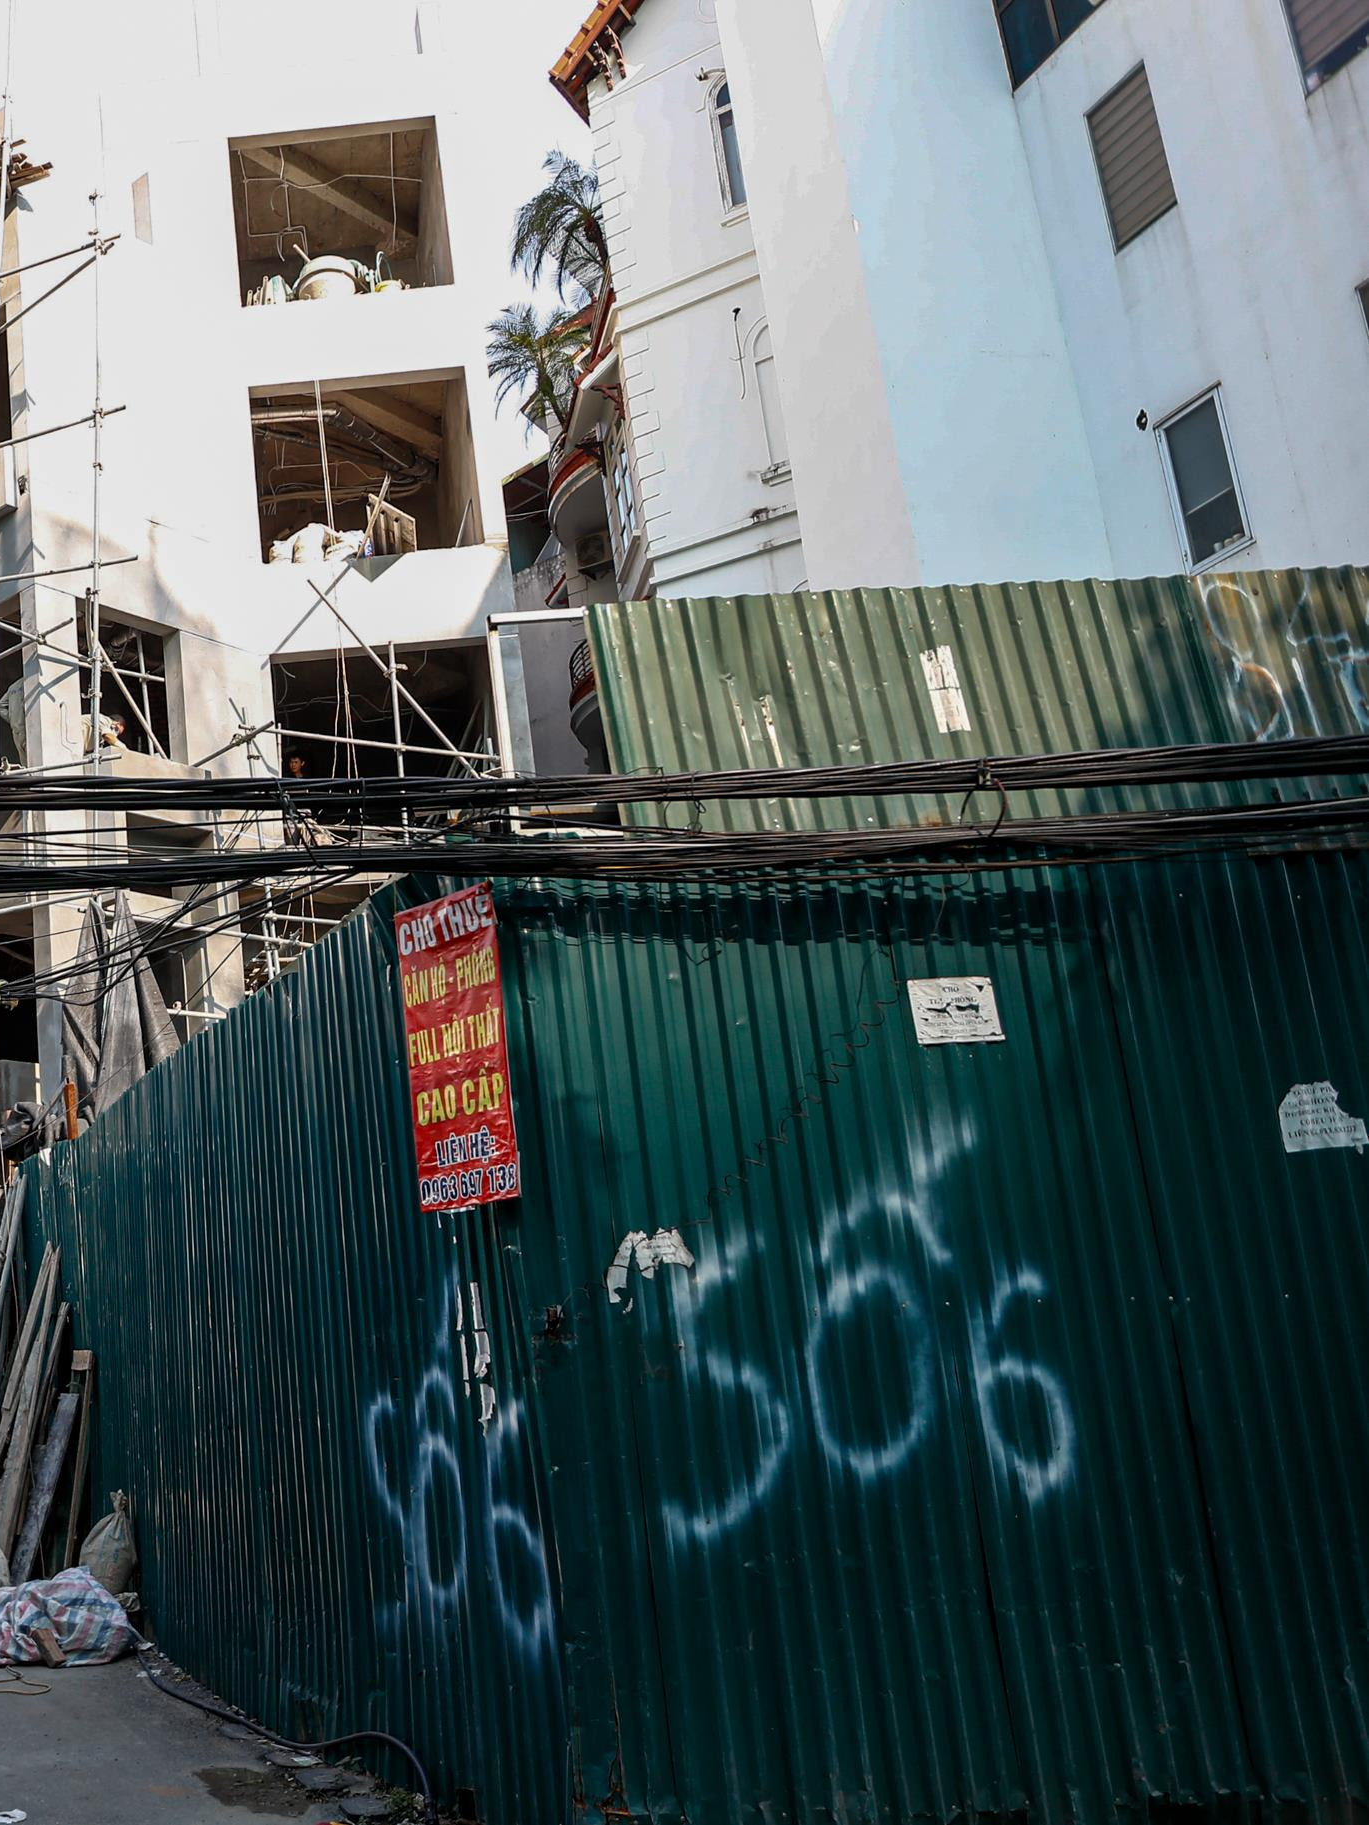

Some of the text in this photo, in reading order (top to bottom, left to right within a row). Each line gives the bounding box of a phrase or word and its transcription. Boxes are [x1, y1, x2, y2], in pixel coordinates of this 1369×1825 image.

[399, 888, 493, 956] CHO THUÊ
[409, 1027, 441, 1068] FULL
[416, 1061, 504, 1126] CAO CẤP
[435, 1132, 469, 1168] LIÊN
[421, 1163, 517, 1206] 0963 697 138
